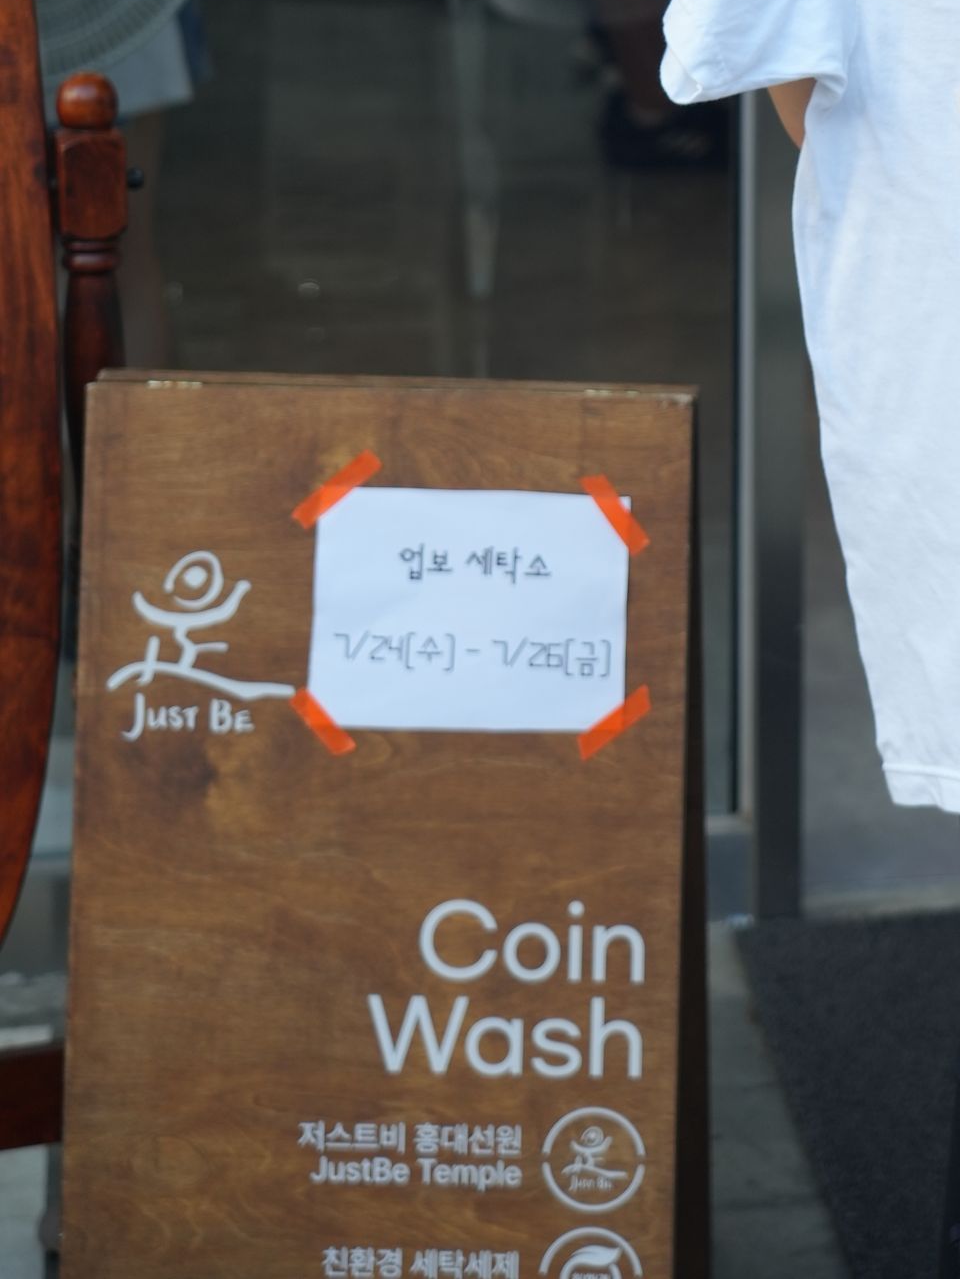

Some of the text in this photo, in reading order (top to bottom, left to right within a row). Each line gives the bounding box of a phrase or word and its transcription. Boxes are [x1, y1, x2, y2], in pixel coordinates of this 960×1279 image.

[398, 544, 552, 584] 업보 세탁소
[419, 899, 646, 984] Coin
[367, 992, 643, 1079] Wash
[297, 1121, 522, 1153] 저스트비 홍대선원
[310, 1156, 522, 1193] JustBe Temple
[322, 1247, 402, 1279] 친환경
